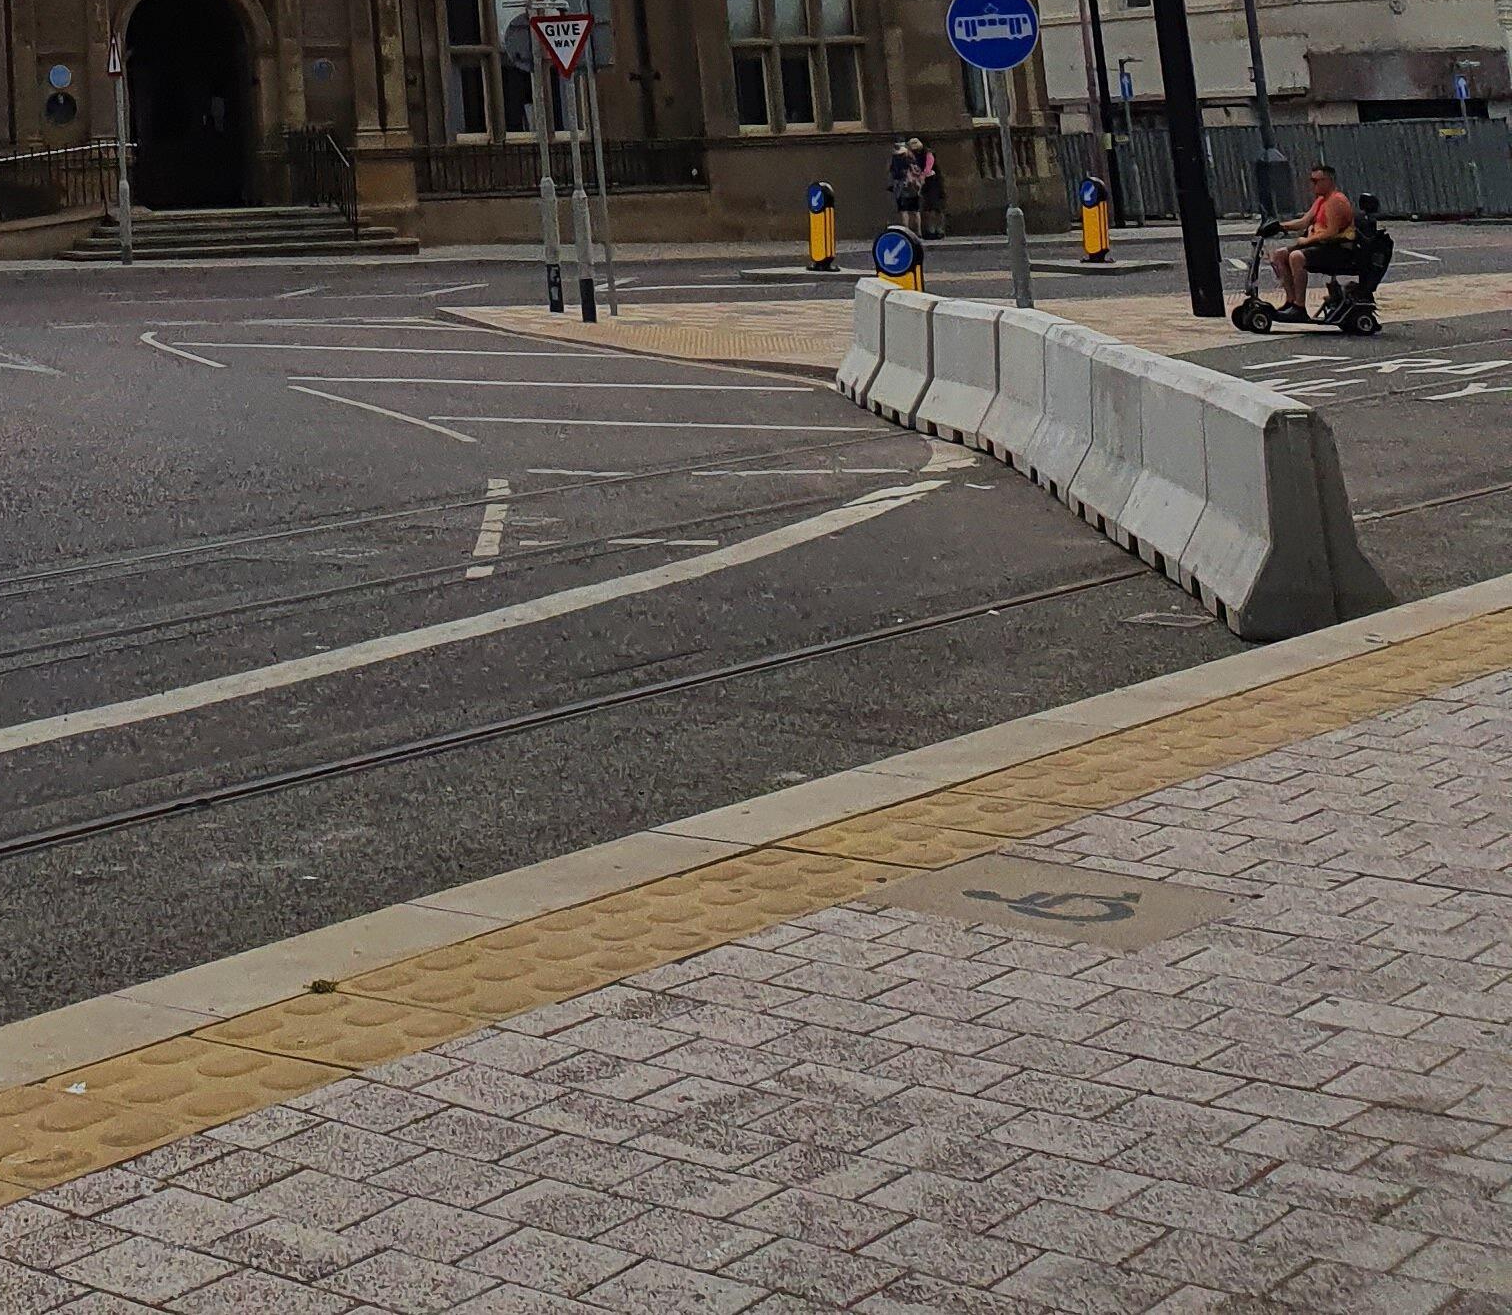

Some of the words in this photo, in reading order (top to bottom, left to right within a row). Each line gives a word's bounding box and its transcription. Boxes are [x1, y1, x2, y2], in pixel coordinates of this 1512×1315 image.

[544, 23, 581, 37] GIVE
[554, 39, 576, 48] WAY
[1242, 354, 1512, 374] TRA
